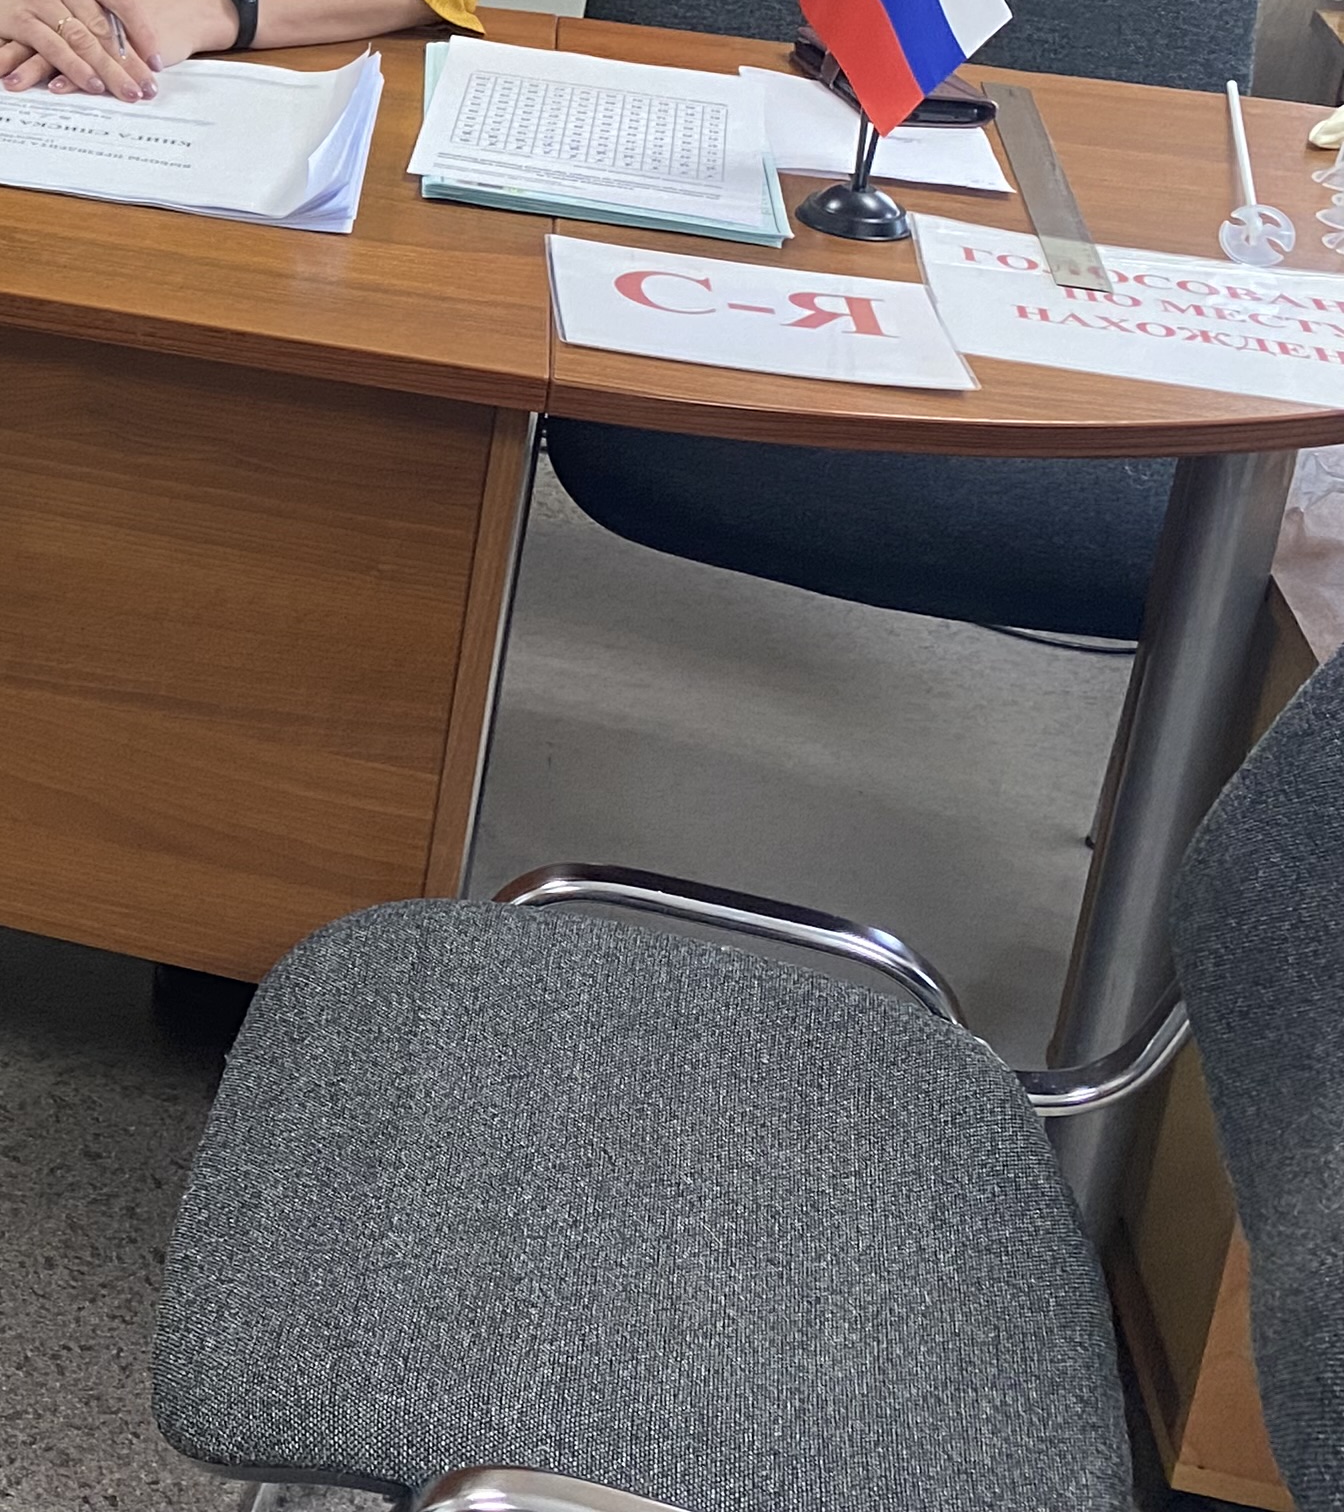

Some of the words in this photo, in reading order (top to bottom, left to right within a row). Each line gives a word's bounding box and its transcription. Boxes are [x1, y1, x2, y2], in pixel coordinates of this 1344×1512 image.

[19, 119, 111, 136] СПИСКА
[118, 132, 192, 148] КНИГА
[613, 268, 900, 340] С-Я
[1063, 286, 1143, 308] ПО
